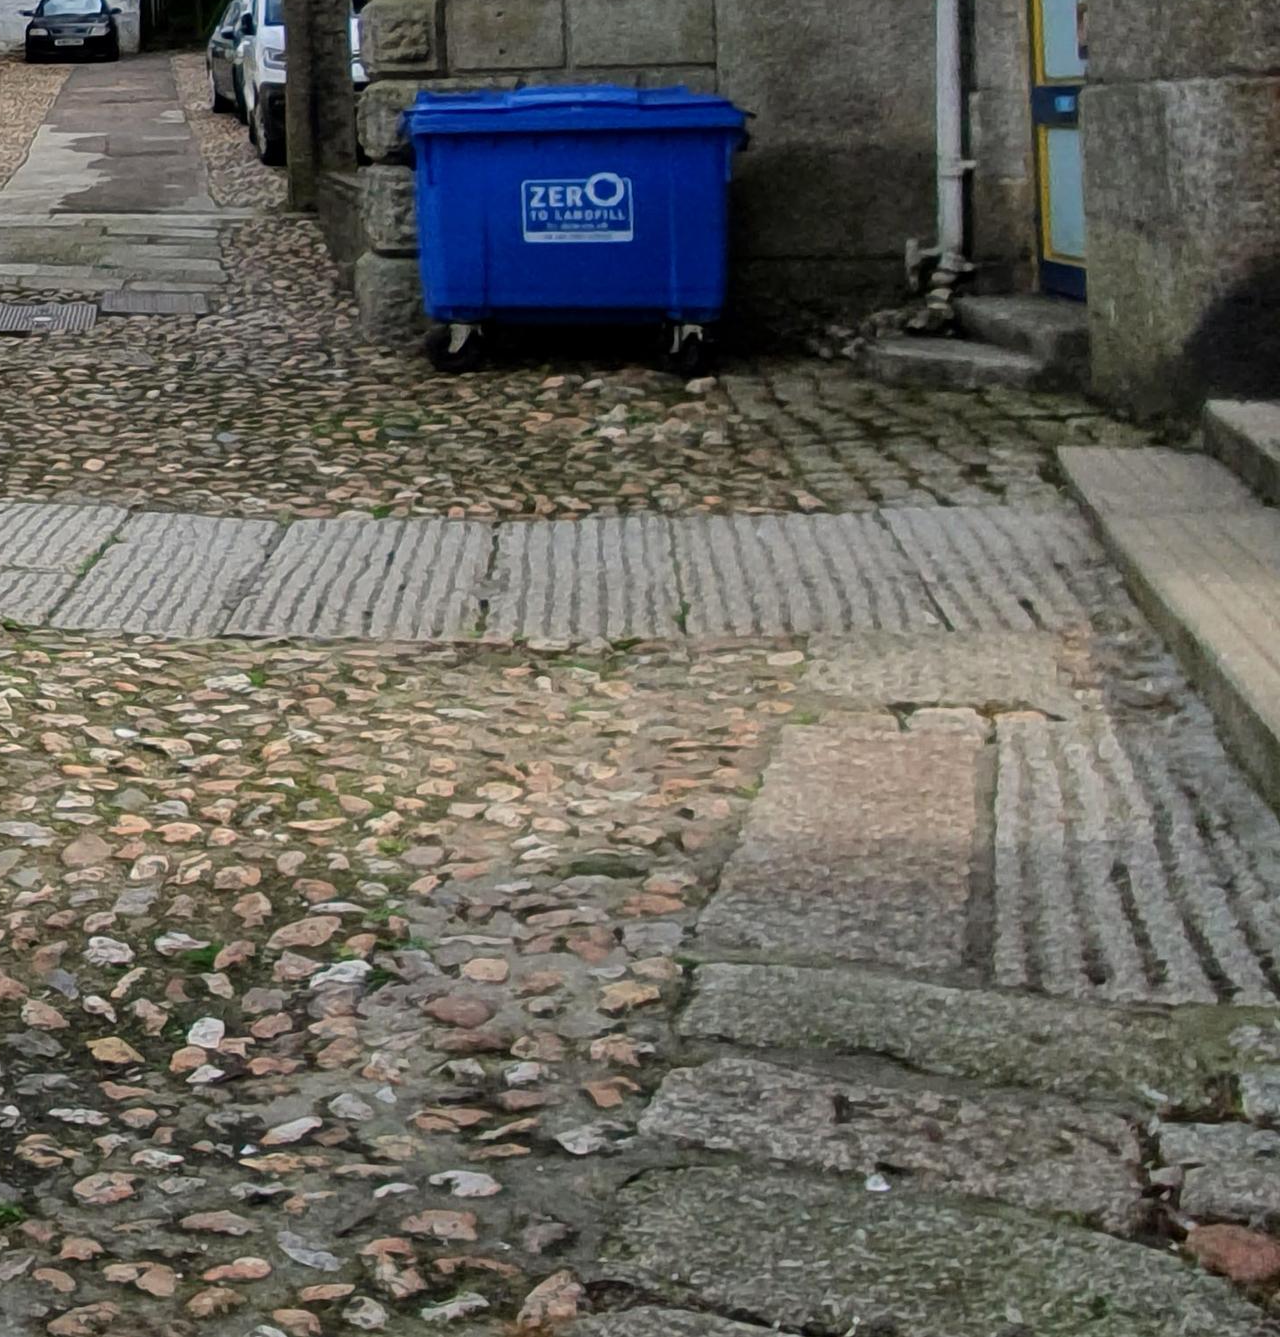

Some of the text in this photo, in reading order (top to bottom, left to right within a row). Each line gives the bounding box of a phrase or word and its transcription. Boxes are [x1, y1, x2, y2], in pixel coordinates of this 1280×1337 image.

[529, 172, 625, 207] ZERO
[530, 208, 626, 221] TO LANDFILL
